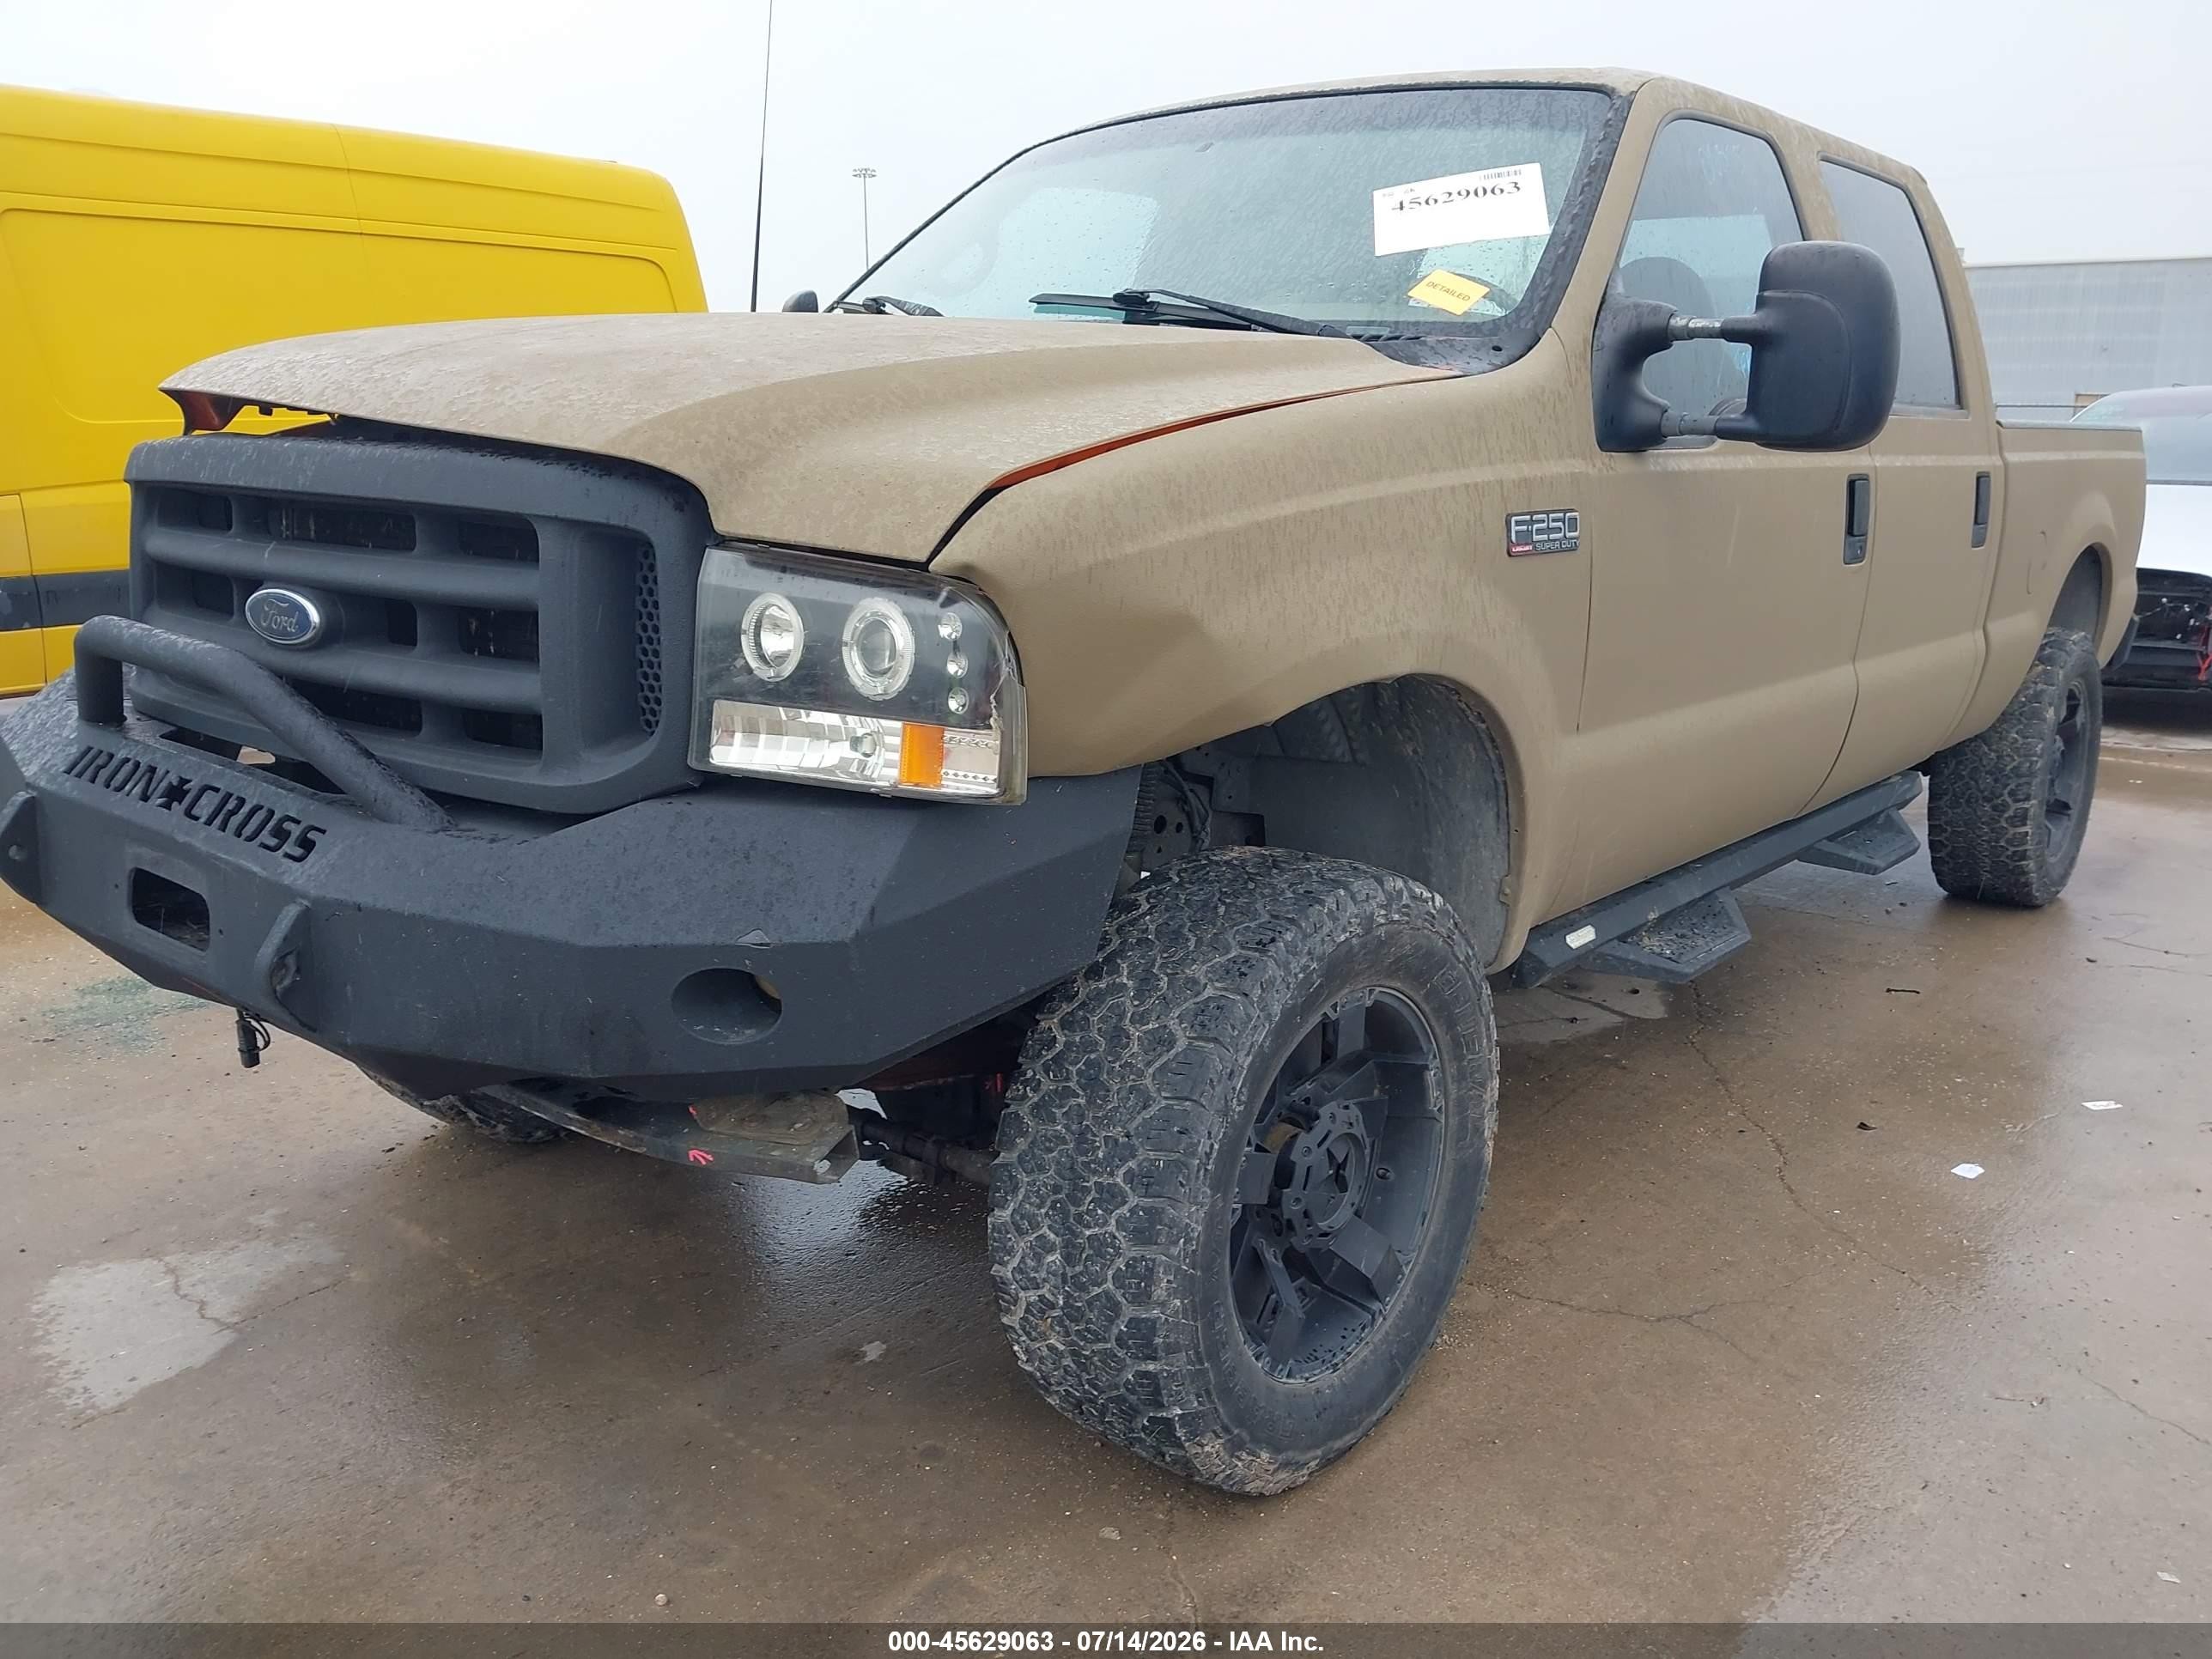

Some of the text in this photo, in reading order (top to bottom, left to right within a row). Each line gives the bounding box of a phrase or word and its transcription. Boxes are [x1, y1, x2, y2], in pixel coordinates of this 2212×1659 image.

[1391, 181, 1522, 212] 45629063
[1426, 280, 1472, 303] DETAILED
[1535, 539, 1580, 550] SUPER DUTY
[260, 599, 299, 633] Ford
[64, 745, 327, 864] IRON CROSS
